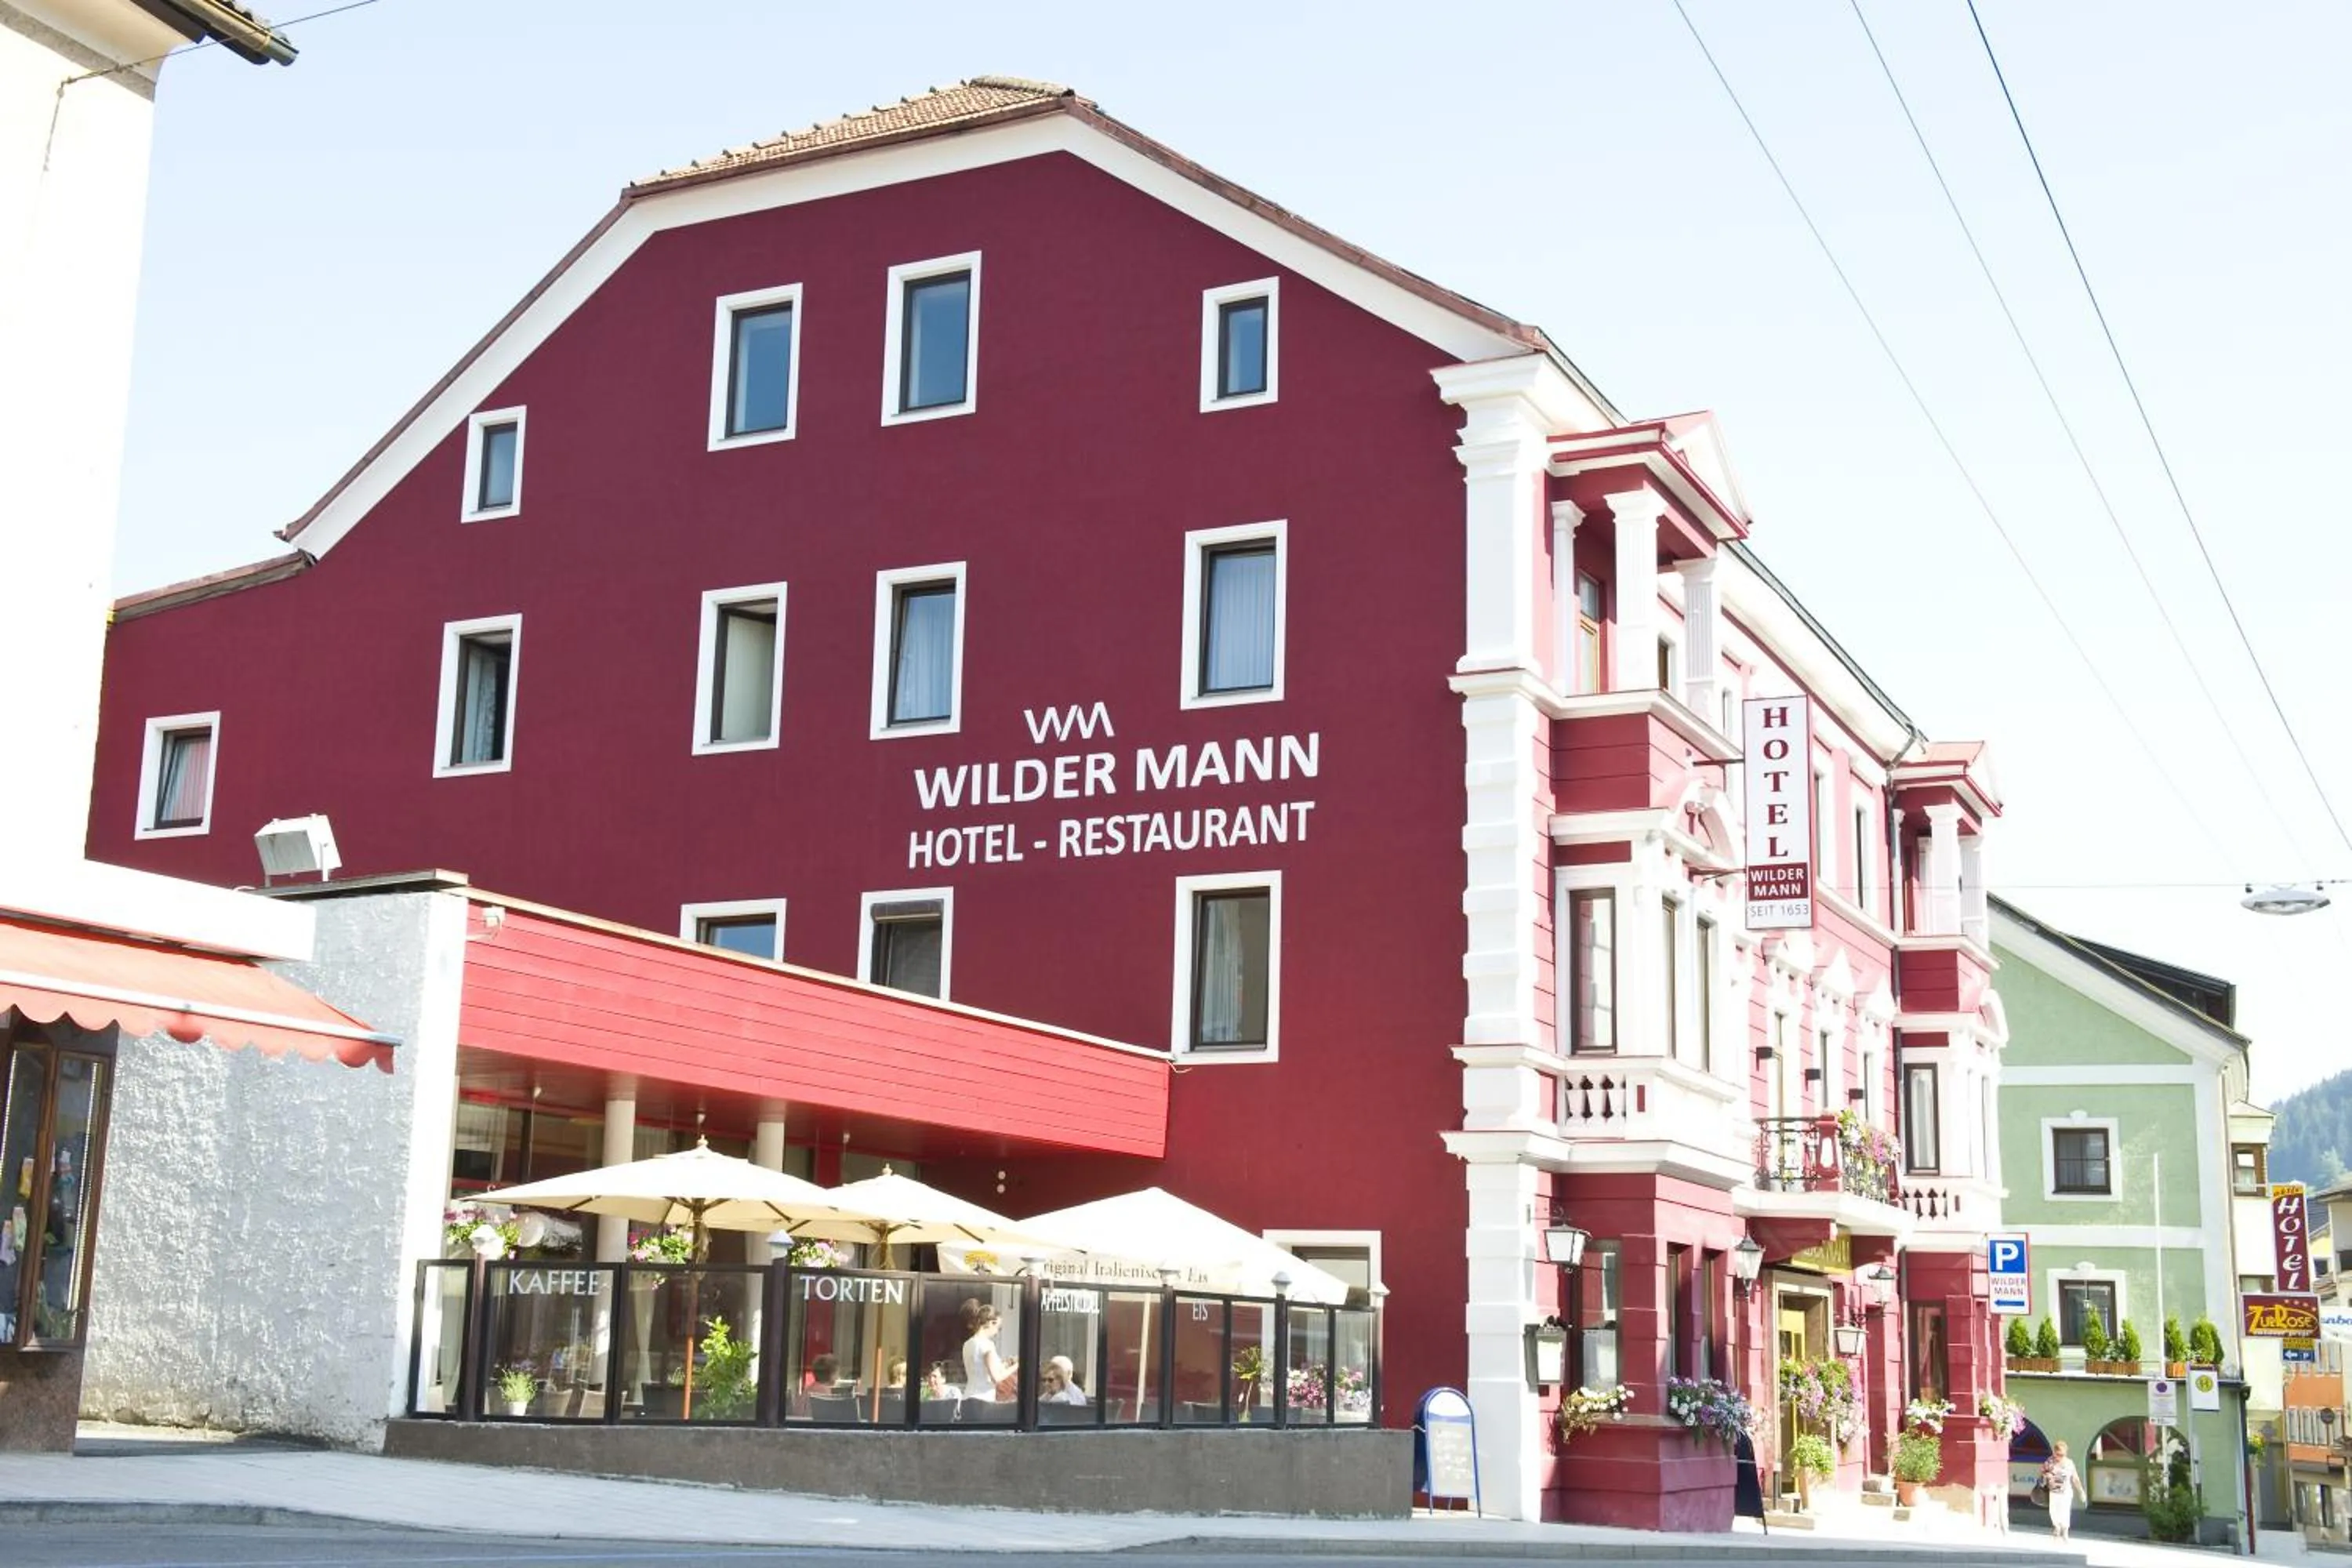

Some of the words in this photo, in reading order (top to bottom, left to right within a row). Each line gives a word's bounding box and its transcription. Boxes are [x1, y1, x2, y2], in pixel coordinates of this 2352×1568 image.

[914, 751, 1116, 810] WILDER
[1135, 731, 1319, 792] MANN
[1762, 706, 1789, 858] HOTEL
[909, 823, 1024, 869] HOTEL
[1059, 800, 1316, 858] RESTAURANT
[1750, 868, 1805, 882] WILDER
[1753, 883, 1802, 898] MANN
[1750, 905, 1774, 917] SEIT
[1780, 904, 1809, 916] 1653
[1995, 1242, 2019, 1271] P
[1043, 1259, 1088, 1279] riginal
[1094, 1261, 1181, 1280] Italieniscs
[508, 1269, 601, 1296] KAFFEE
[799, 1274, 904, 1305] TORTEN
[1994, 1287, 2024, 1295] MANN
[1192, 1301, 1209, 1321] EIS
